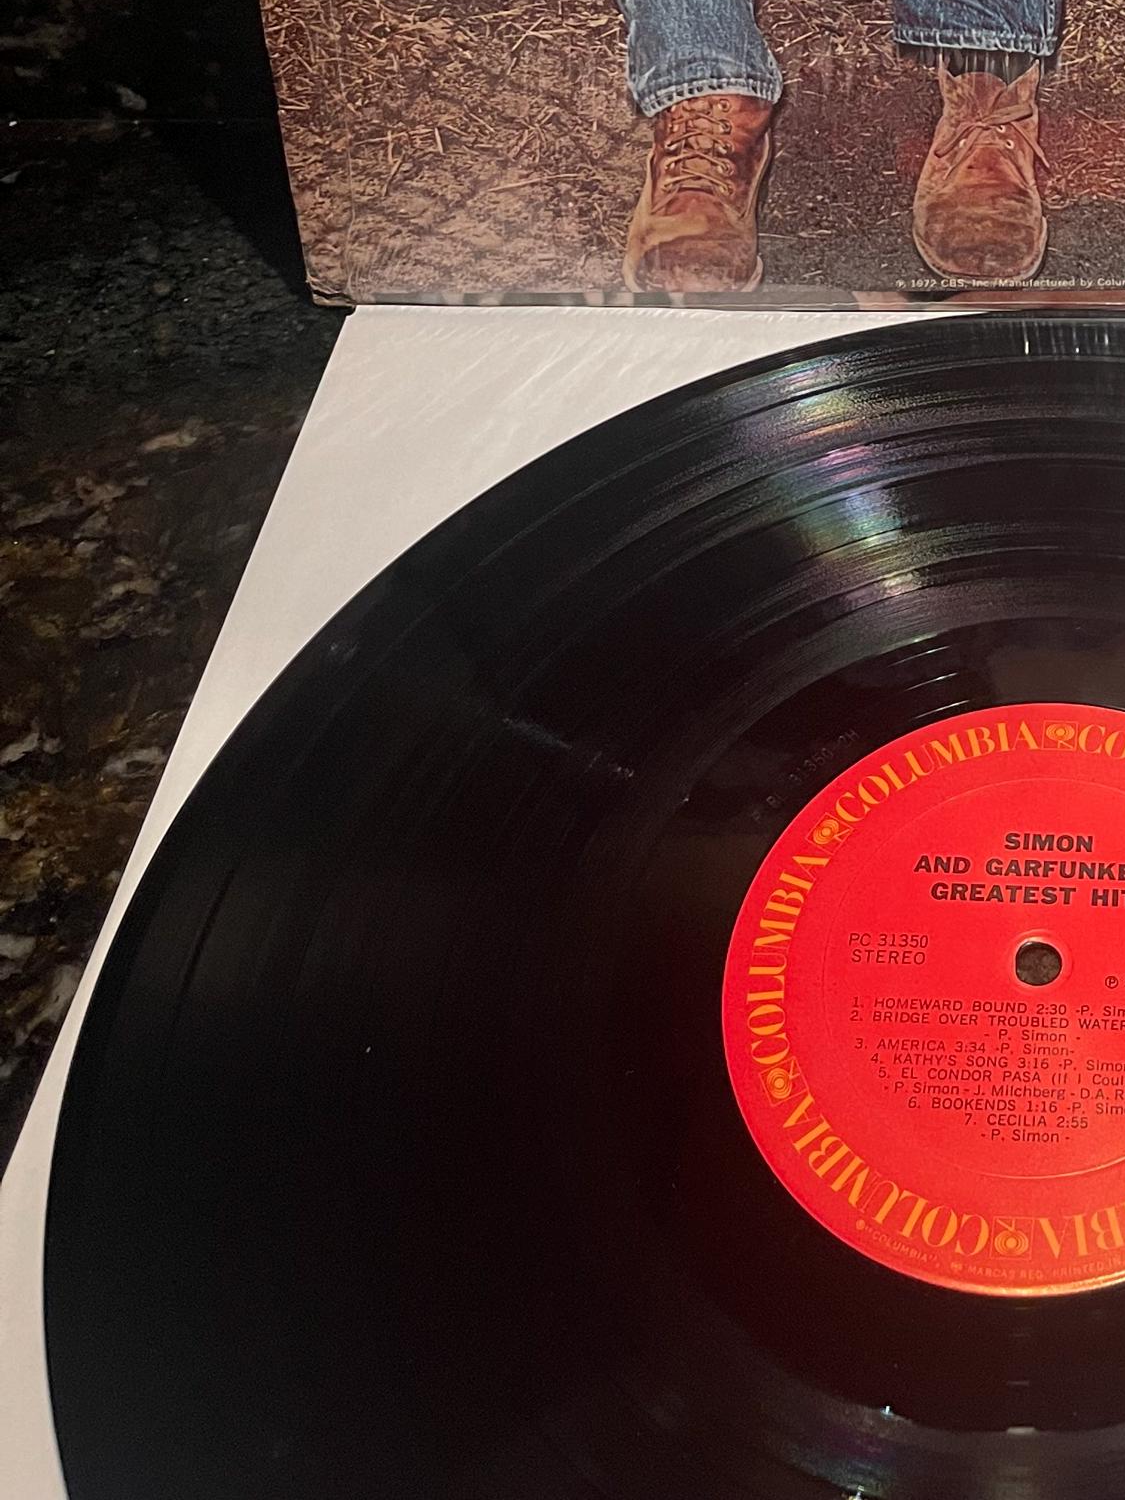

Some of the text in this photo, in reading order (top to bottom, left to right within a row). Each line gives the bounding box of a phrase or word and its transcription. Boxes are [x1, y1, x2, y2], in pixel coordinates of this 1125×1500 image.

[1080, 279, 1093, 289] by
[834, 721, 1039, 824] COLUMBIA
[1005, 832, 1093, 852] SIMON
[914, 855, 971, 874] AND
[930, 882, 1077, 905] GREATEST
[849, 933, 928, 949] PC 31350
[748, 855, 829, 1065] COLUMBIA
[851, 949, 926, 965] STEREO
[852, 997, 1067, 1015] 1. HOMEWARD BOUND 2:30
[850, 1010, 863, 1022] 2.
[873, 1011, 929, 1024] BRIDGE
[939, 1014, 978, 1025] OVER
[988, 1015, 1069, 1028] TROUBLED
[1022, 1030, 1067, 1042] Simon
[854, 1038, 985, 1053] 3. AMERICA 3:34
[871, 1053, 1049, 1069] 4. KATHY'S SONG 3:16
[879, 1067, 890, 1079] 5.
[902, 1068, 918, 1079] EL
[928, 1068, 992, 1082] CONDOR
[1003, 1071, 1041, 1082] PASA
[913, 1082, 959, 1094] Simon
[992, 1085, 1066, 1100] Milchberg
[908, 1097, 1057, 1113] 6. BOOKENDS 1:16
[964, 1113, 1088, 1128] 7. CECILIA 2:55
[1012, 1129, 1059, 1142] Simon
[778, 1090, 991, 1258] COLUMBIA
